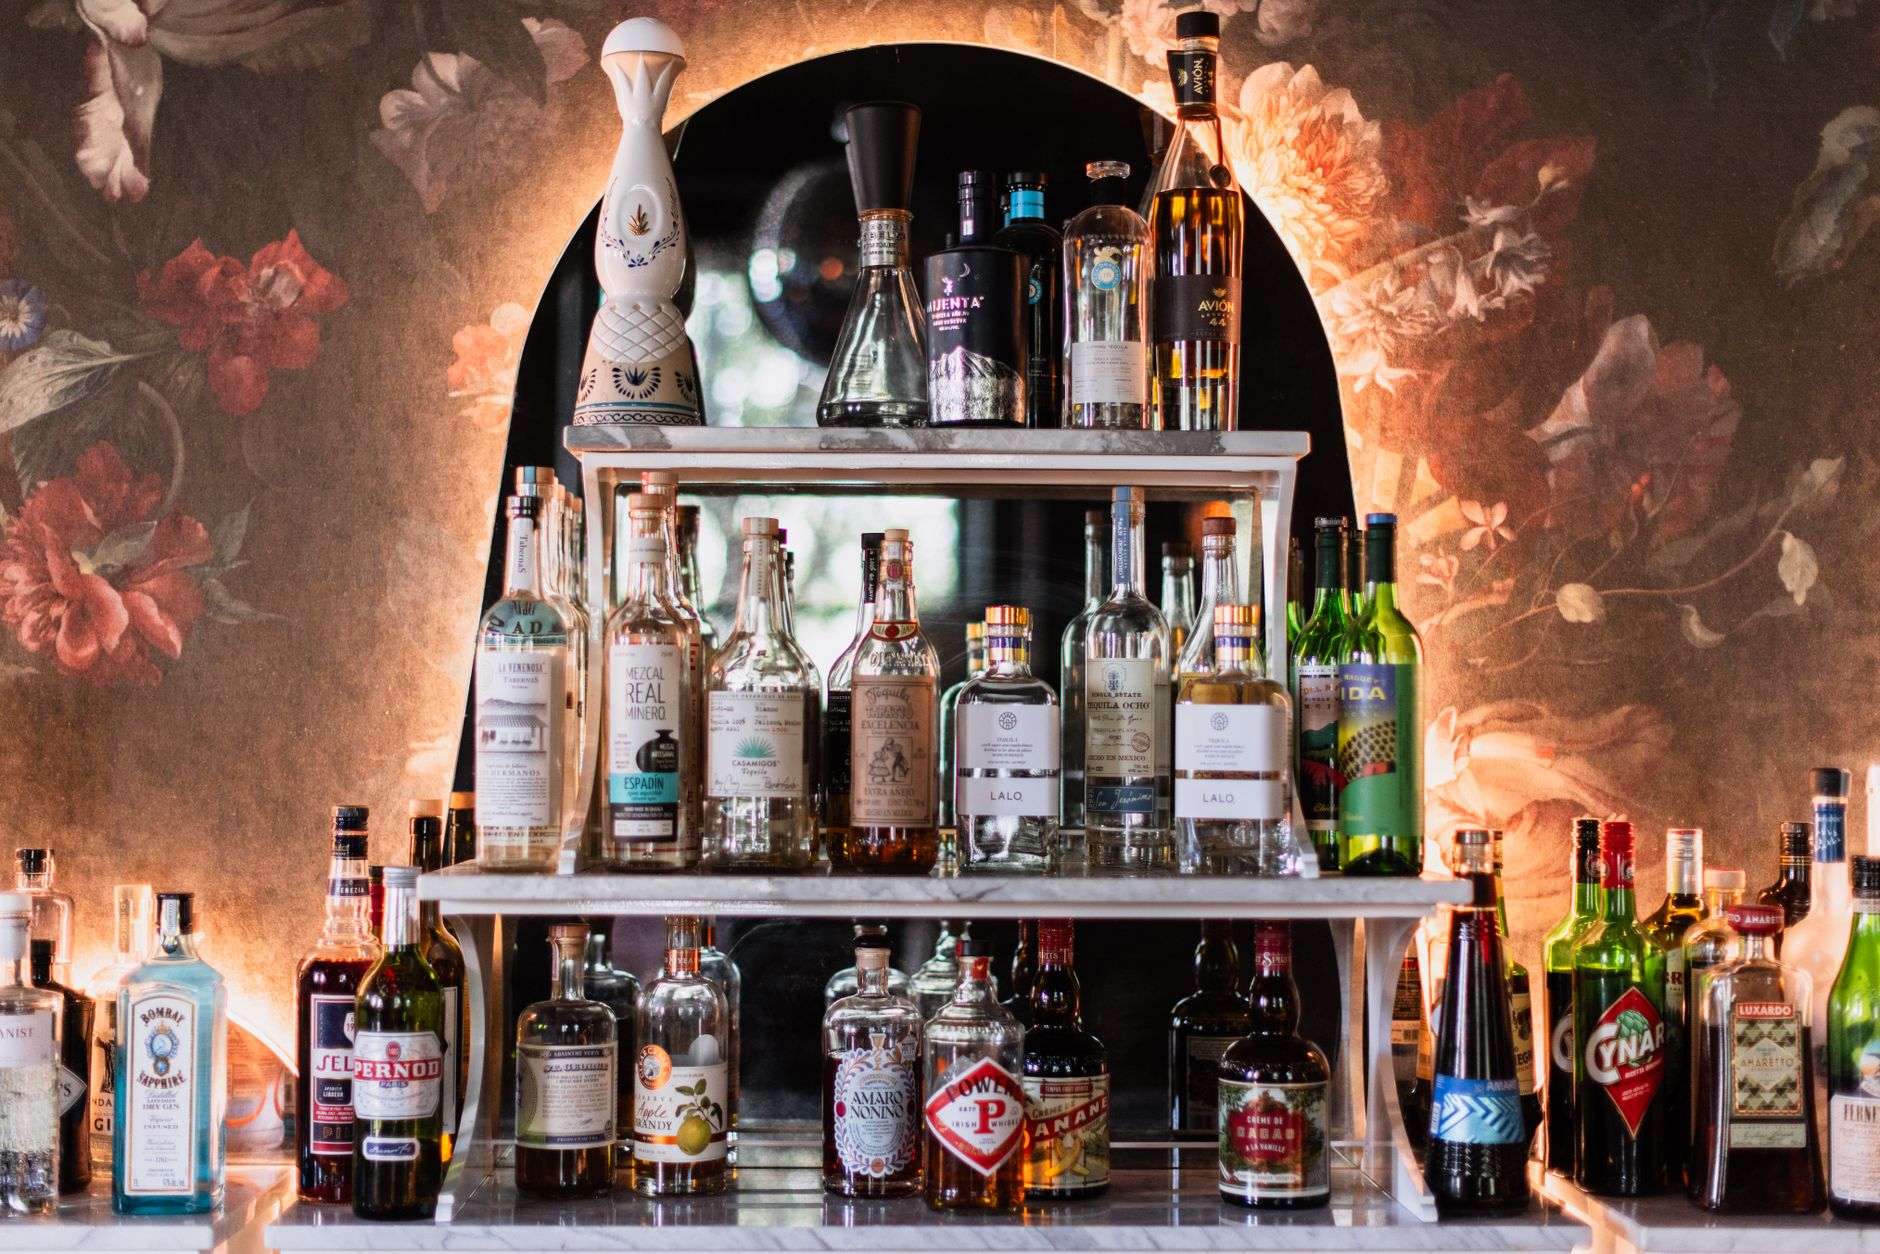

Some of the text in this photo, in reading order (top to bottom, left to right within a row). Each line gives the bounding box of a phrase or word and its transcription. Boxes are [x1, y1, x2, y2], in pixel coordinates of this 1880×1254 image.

[1198, 300, 1234, 312] AVIÓN
[508, 662, 543, 673] VENENOSA
[626, 667, 665, 680] MEZCAL
[625, 682, 666, 704] REAL
[865, 686, 912, 705] Tequila
[1122, 701, 1150, 709] OCHO
[861, 719, 919, 730] EXCELENCIA
[732, 760, 777, 768] CASAMIGOS
[624, 774, 664, 790] ESPADÍN
[991, 791, 1022, 801] LALO
[1202, 793, 1234, 803] LALO
[140, 1007, 184, 1025] BOMBAY
[1740, 1005, 1791, 1016] LUXARDO
[1516, 1051, 1532, 1065] EGR
[1585, 1022, 1665, 1085] CYNAR
[316, 1055, 354, 1072] SEL
[1741, 1057, 1794, 1067] AMARETTO
[354, 1061, 439, 1078] PERNOD
[137, 1070, 186, 1089] SAPPHIRE
[851, 1091, 903, 1105] AMARO
[638, 1101, 667, 1118] Apple
[850, 1104, 904, 1119] NONINO
[974, 1099, 1006, 1134] P
[1843, 1103, 1880, 1122] FERNE
[1030, 1096, 1108, 1138] ANANE
[1273, 1117, 1283, 1125] DE
[1260, 1143, 1285, 1153] VANILLE
